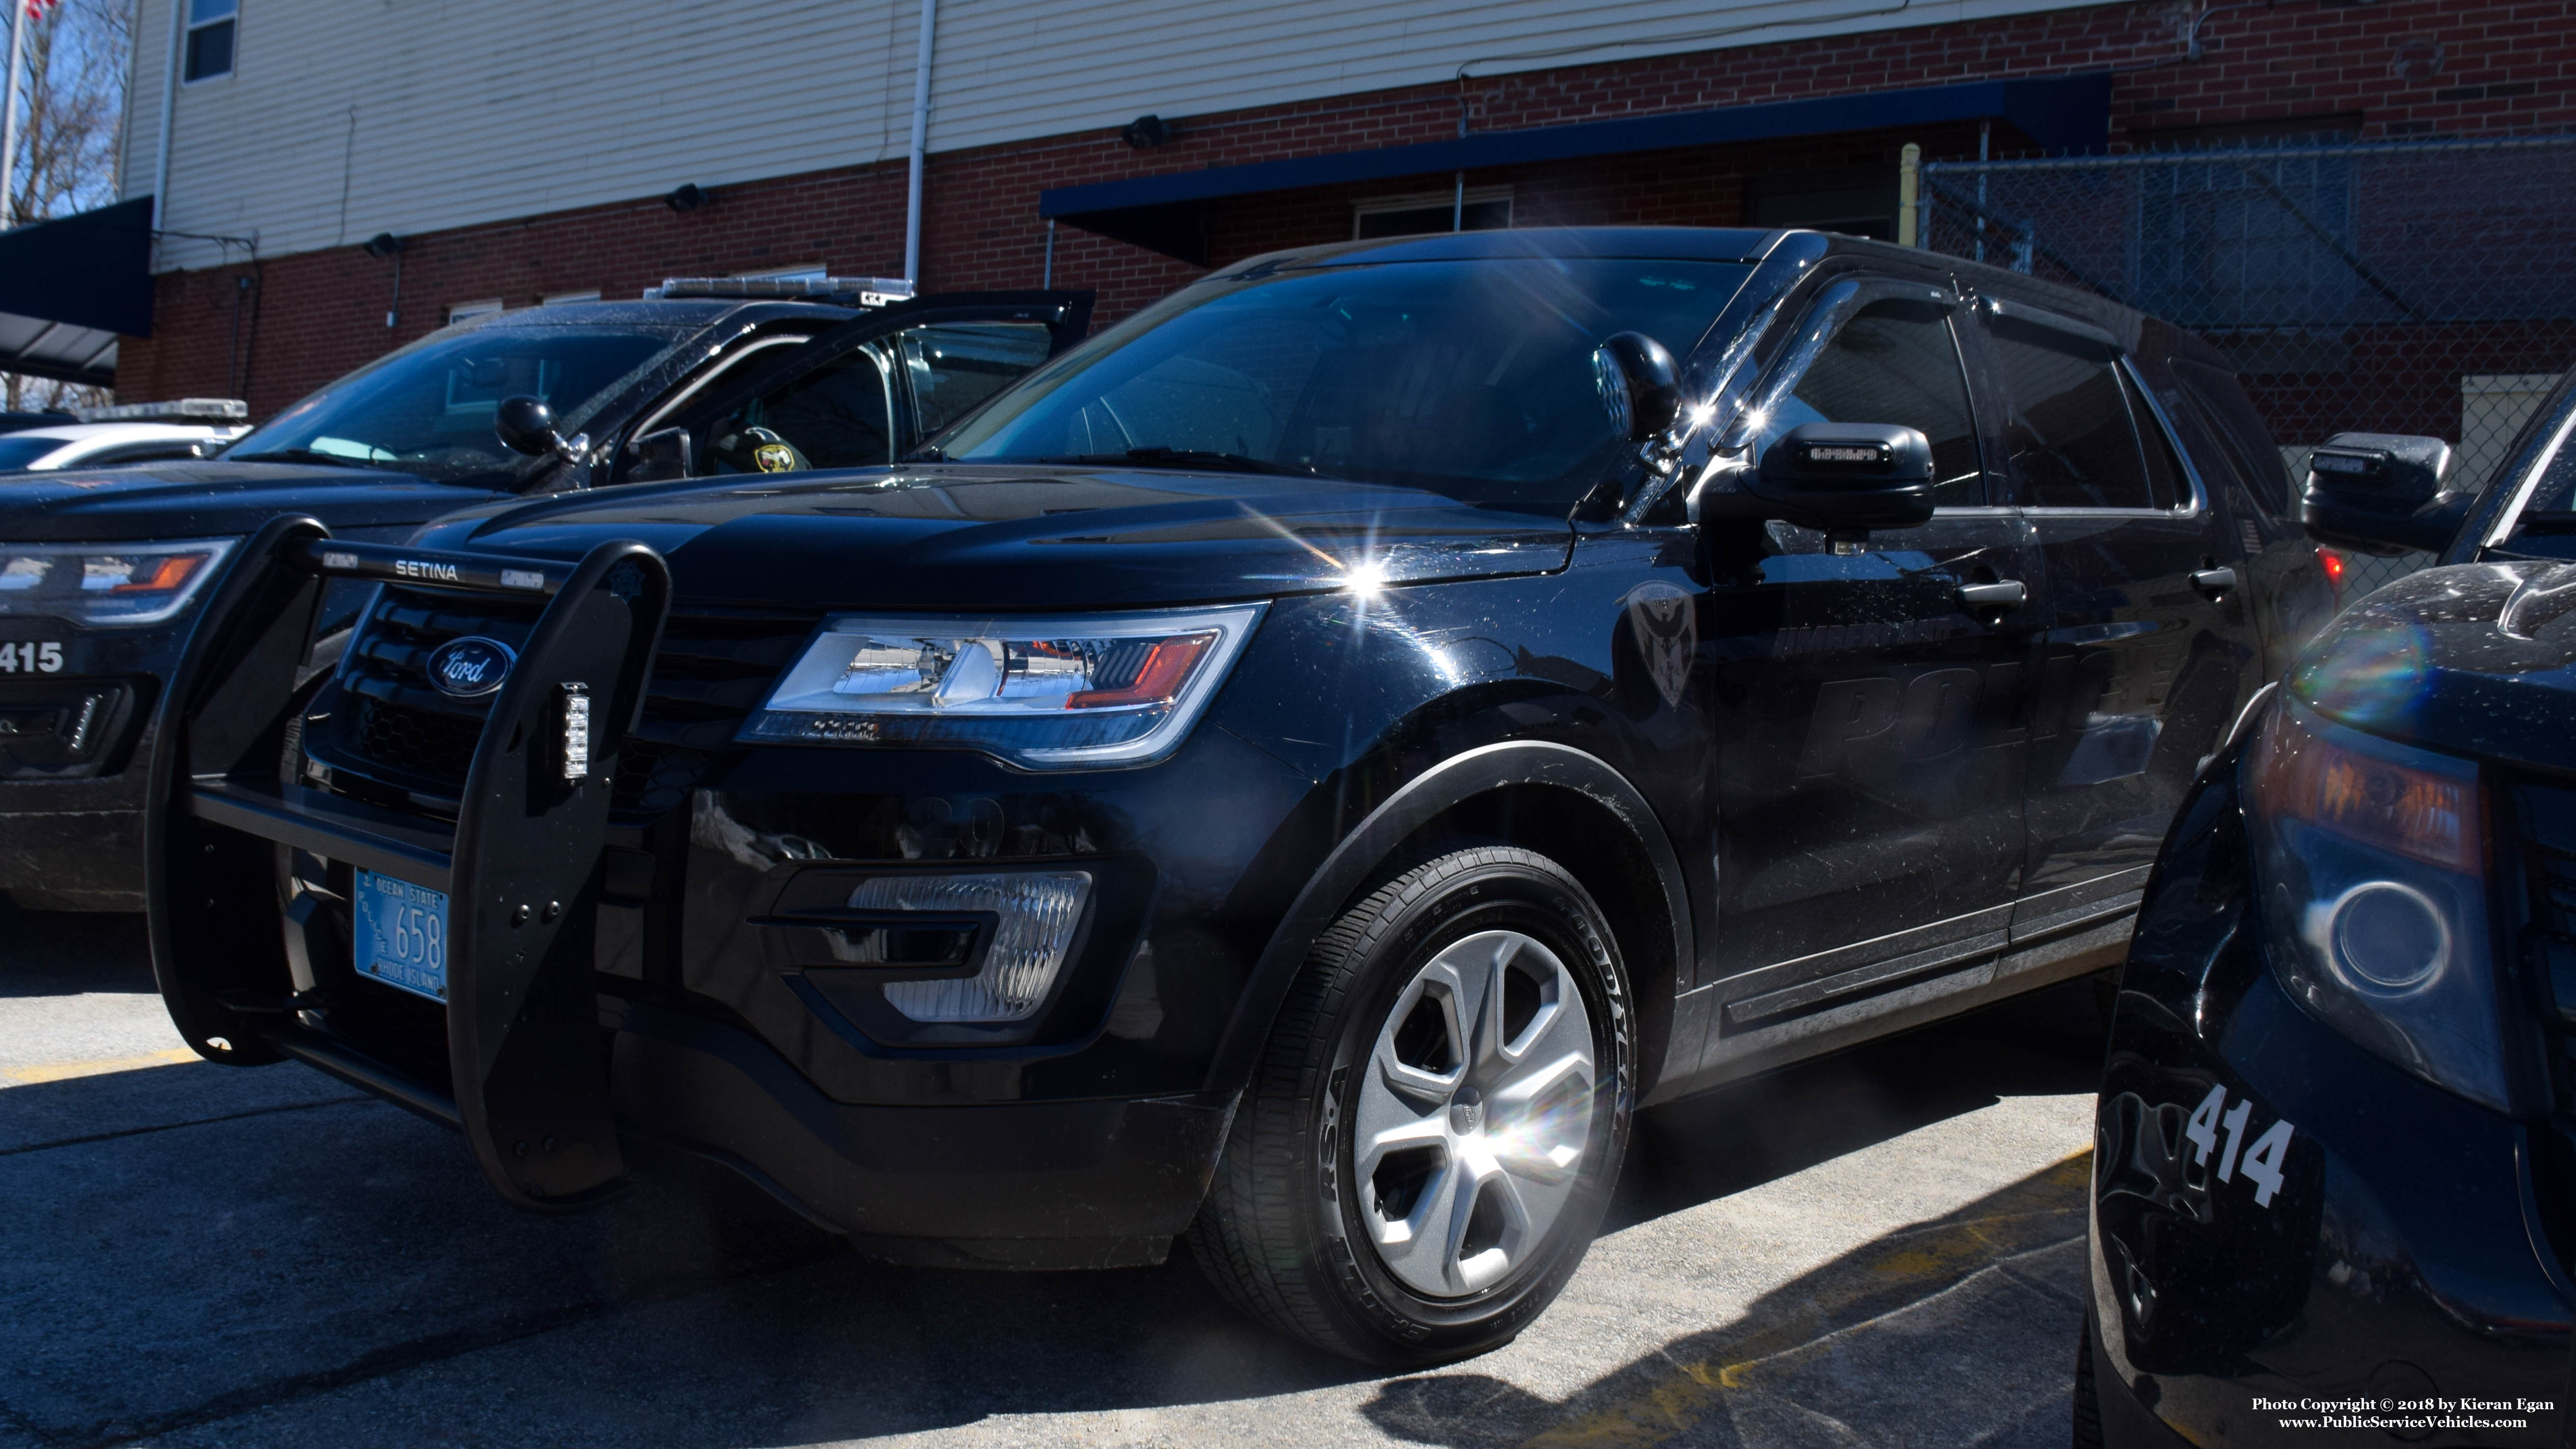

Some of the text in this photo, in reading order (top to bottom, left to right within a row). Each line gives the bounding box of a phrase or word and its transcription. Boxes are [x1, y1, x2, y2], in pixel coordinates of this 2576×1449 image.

[395, 560, 458, 581] SETINA
[0, 641, 64, 673] 415
[443, 649, 491, 683] Ford
[376, 877, 439, 908] OCEAN STATE
[359, 892, 388, 953] POLICE
[397, 905, 441, 970] 658
[378, 956, 439, 991] RHODE ISLAND
[1554, 896, 1628, 1145] GOODYEAR
[2185, 1083, 2295, 1210] 414
